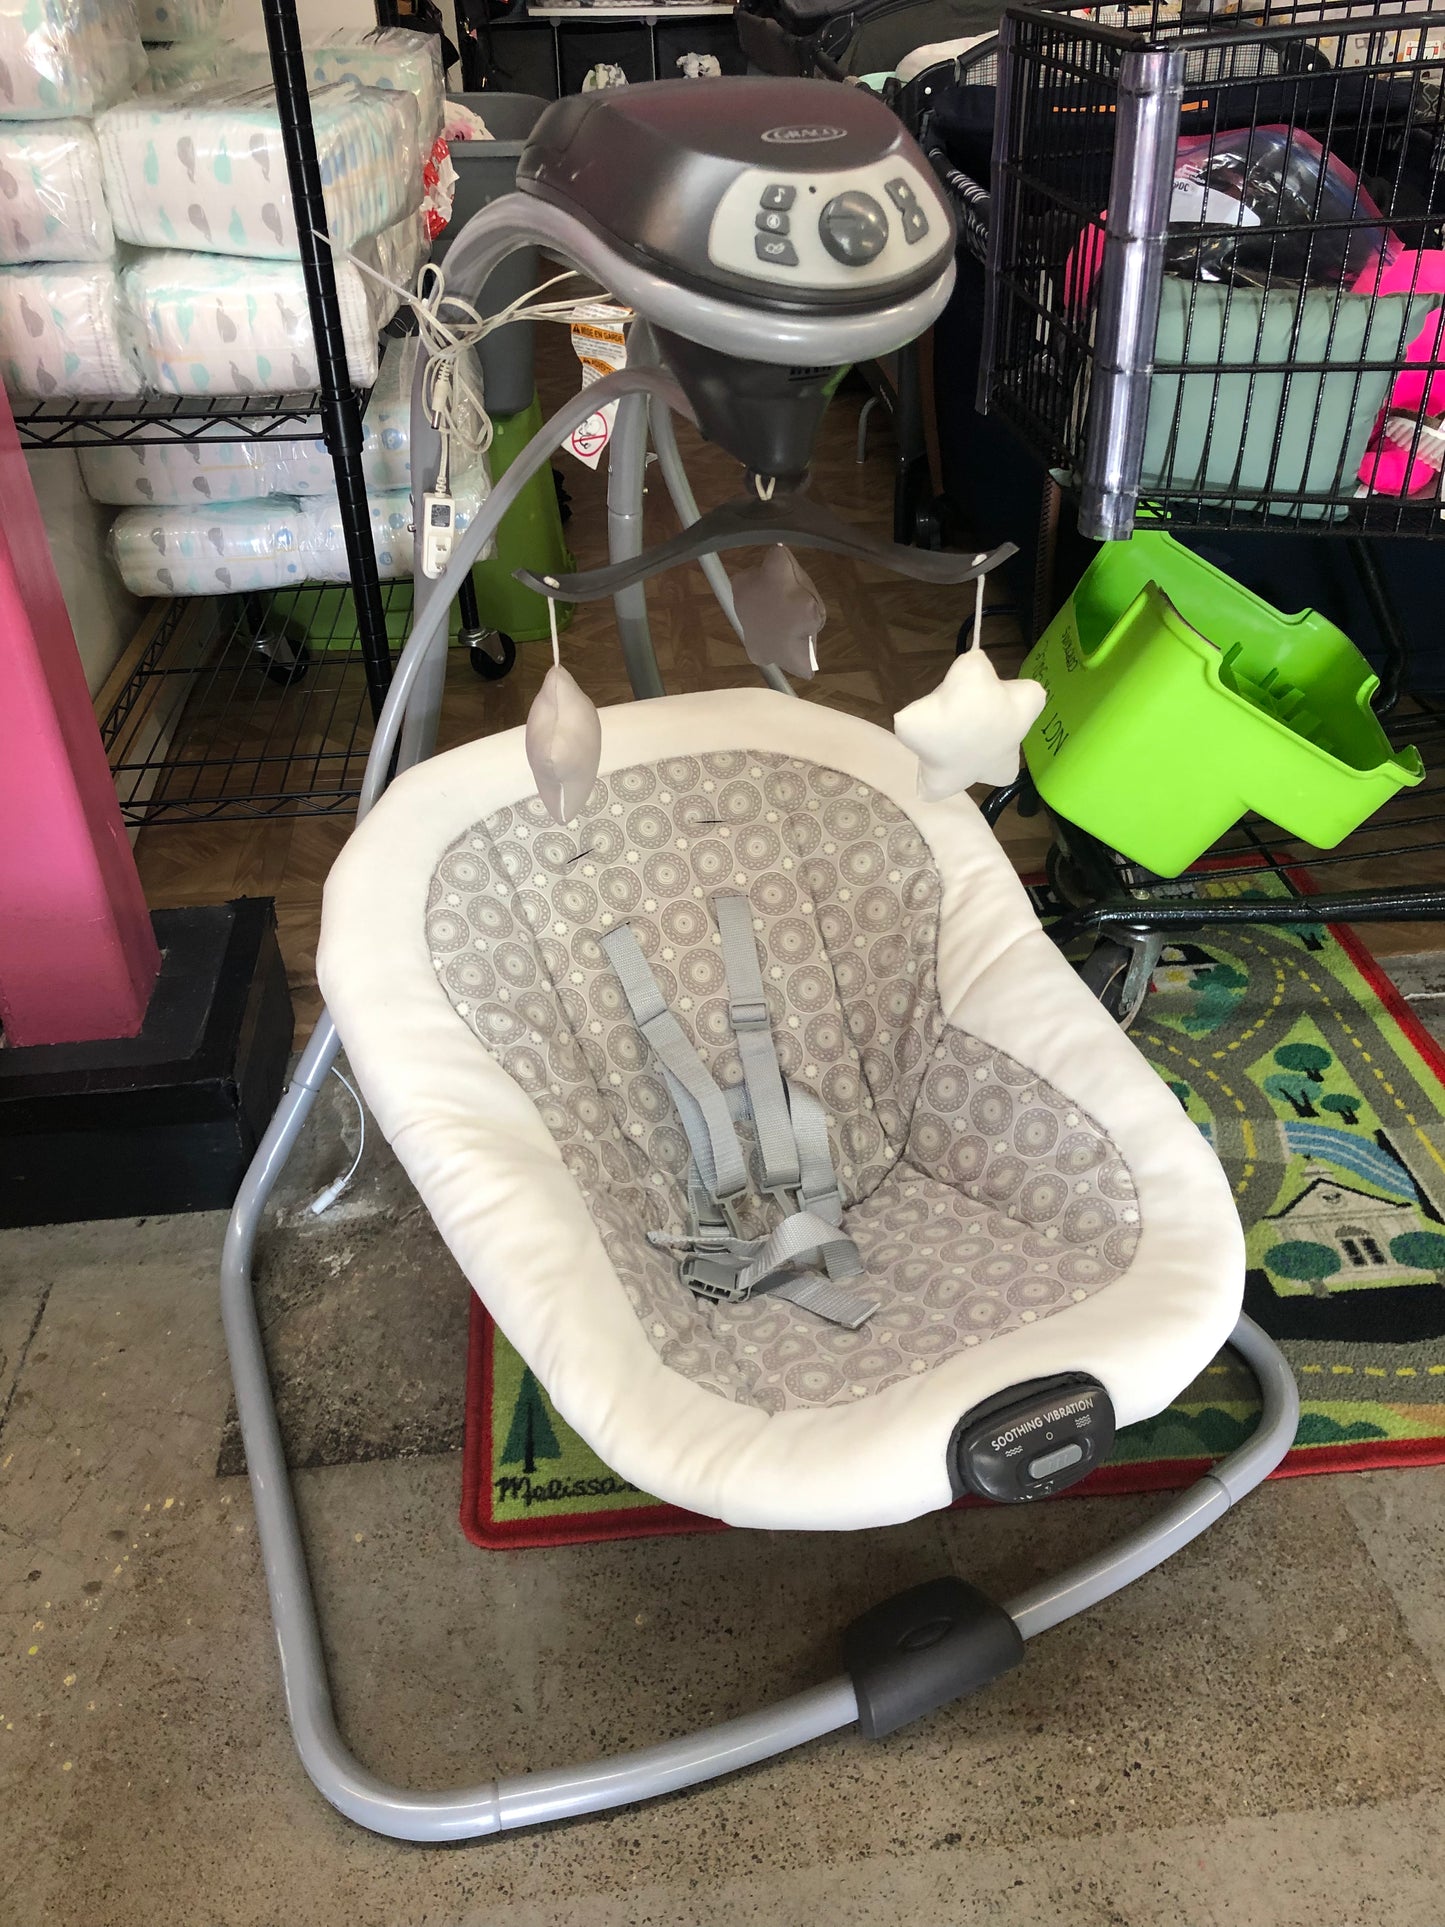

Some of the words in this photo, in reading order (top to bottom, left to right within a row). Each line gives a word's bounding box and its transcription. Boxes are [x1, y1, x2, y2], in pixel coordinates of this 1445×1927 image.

[991, 1417, 1043, 1451] SOOTHING
[1044, 1398, 1094, 1424] VIBRATION
[495, 1476, 622, 1507] Melissa
